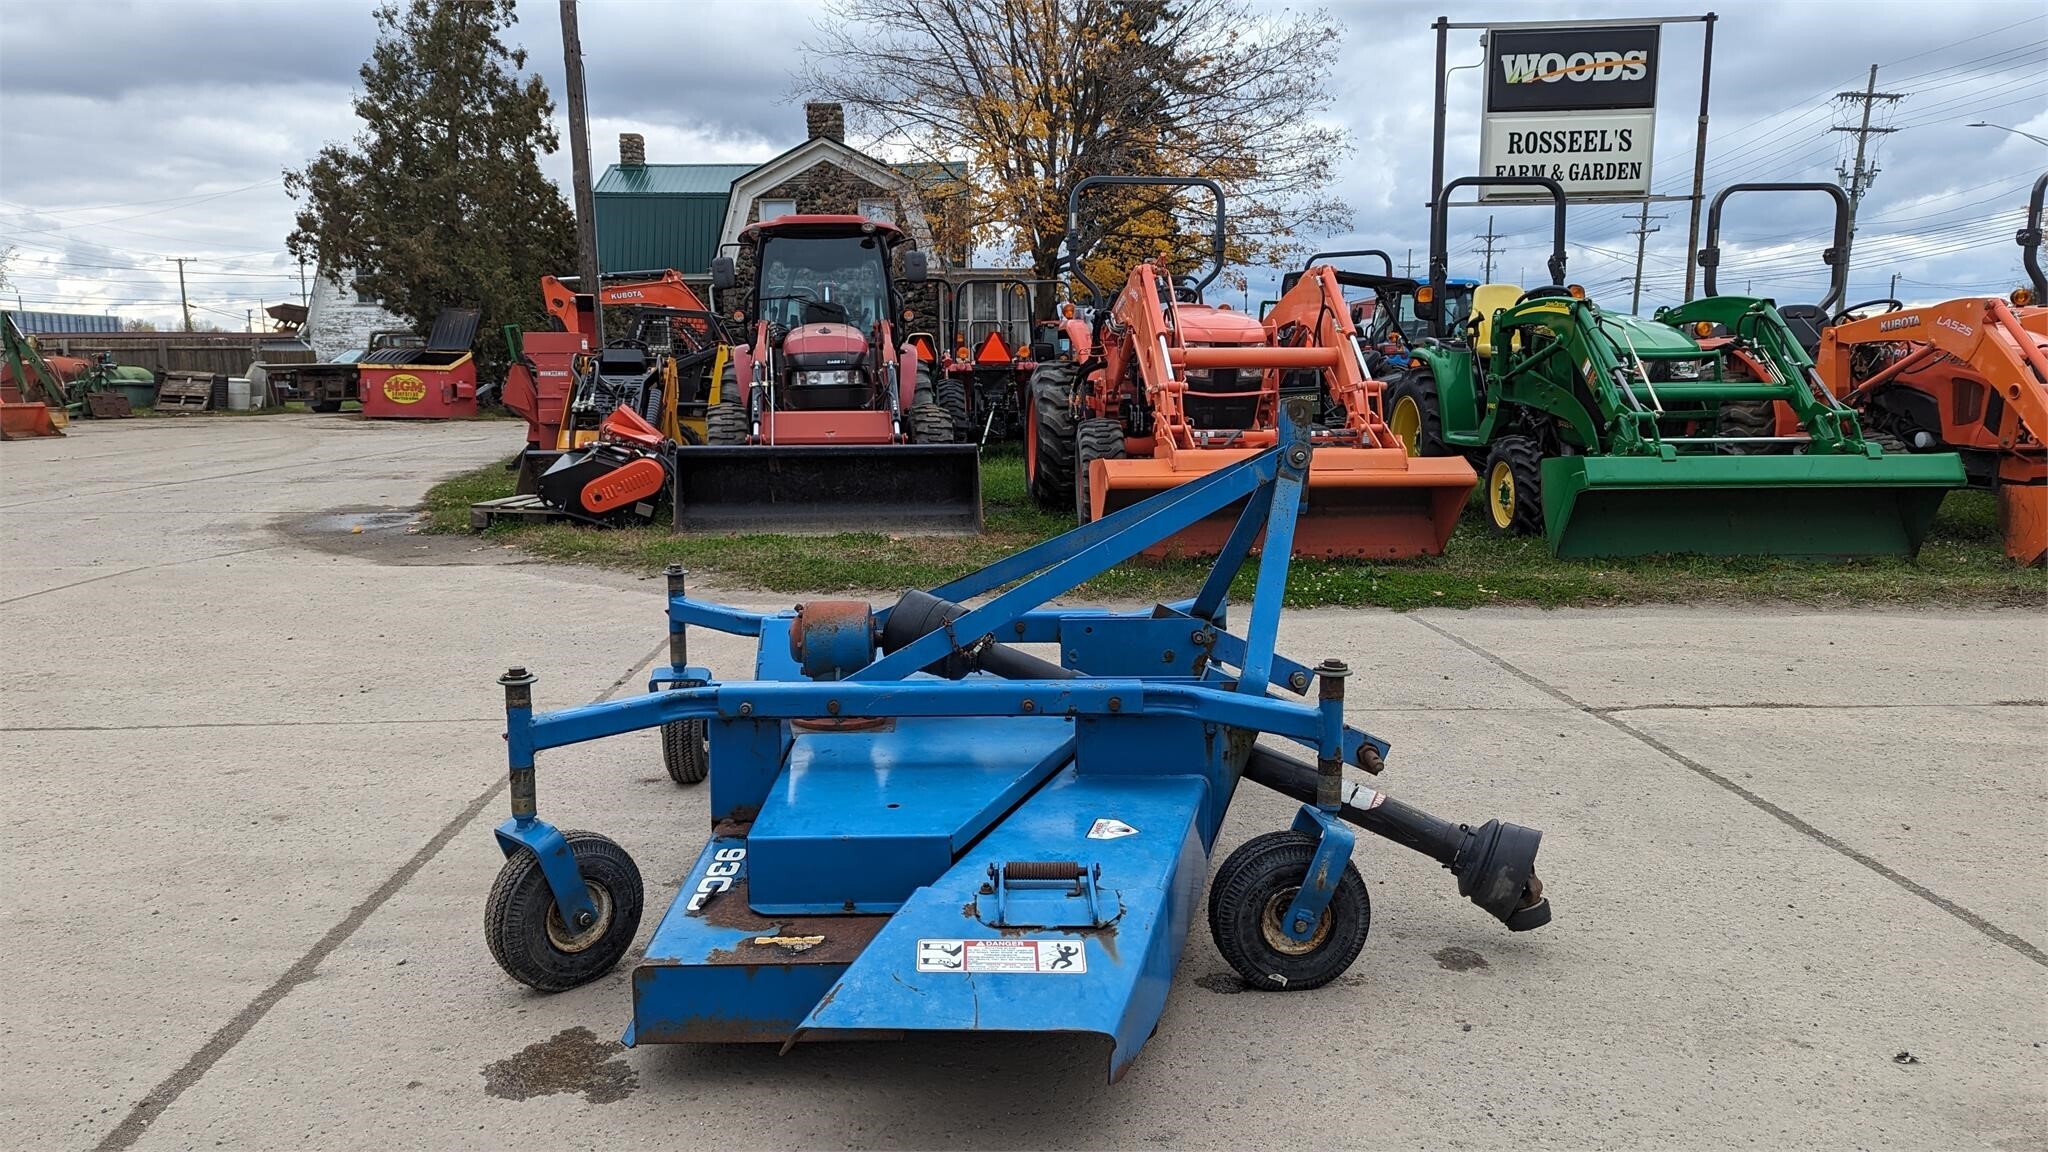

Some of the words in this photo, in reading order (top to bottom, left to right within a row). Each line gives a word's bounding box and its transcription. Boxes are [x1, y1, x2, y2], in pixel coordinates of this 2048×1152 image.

[1501, 50, 1648, 84] WOODS
[1507, 129, 1633, 154] ROSSEEL'S
[1495, 163, 1547, 178] FARM
[1550, 163, 1565, 182] &
[1568, 162, 1643, 182] GARDEN
[611, 290, 643, 300] KUBOTA
[1880, 315, 1920, 332] KUBOTA
[1936, 316, 1973, 337] LA525
